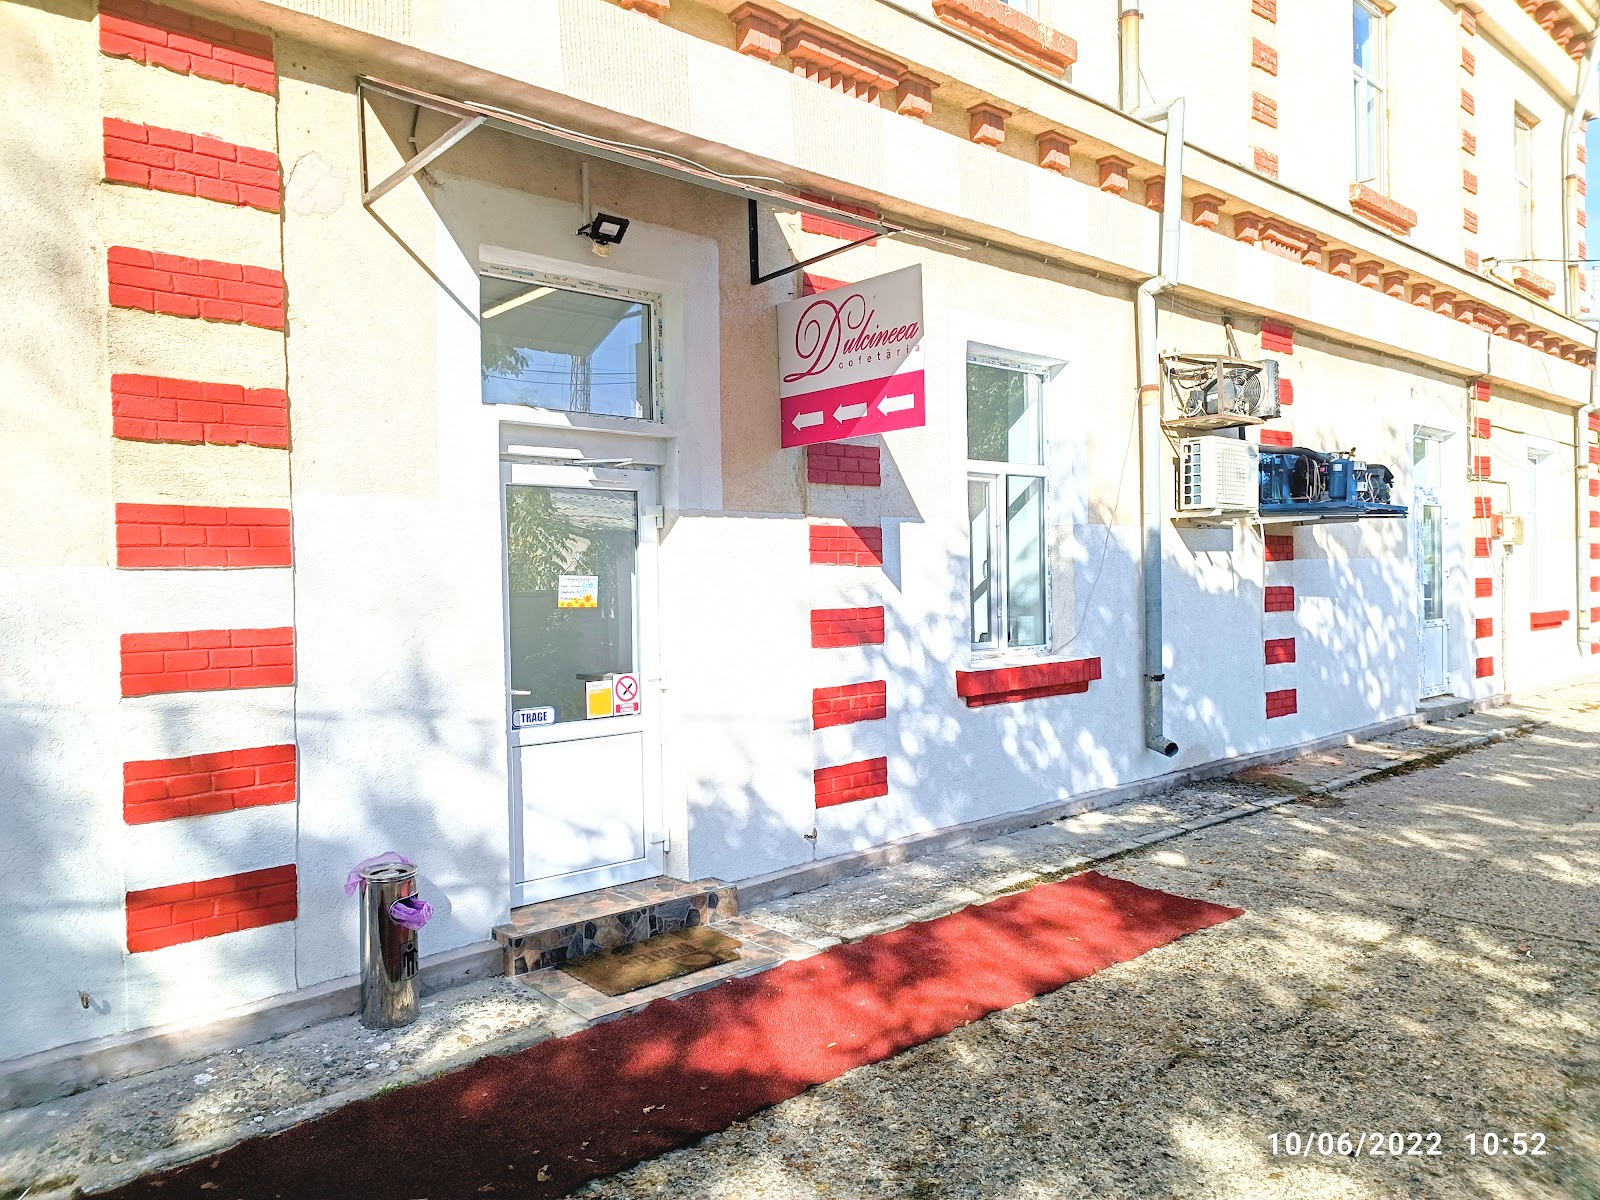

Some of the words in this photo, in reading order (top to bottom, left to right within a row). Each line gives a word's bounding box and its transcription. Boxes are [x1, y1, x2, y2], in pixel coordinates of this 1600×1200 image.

[783, 293, 920, 383] Dulcineea
[838, 344, 920, 370] cofetăria
[521, 711, 548, 723] TRAGE
